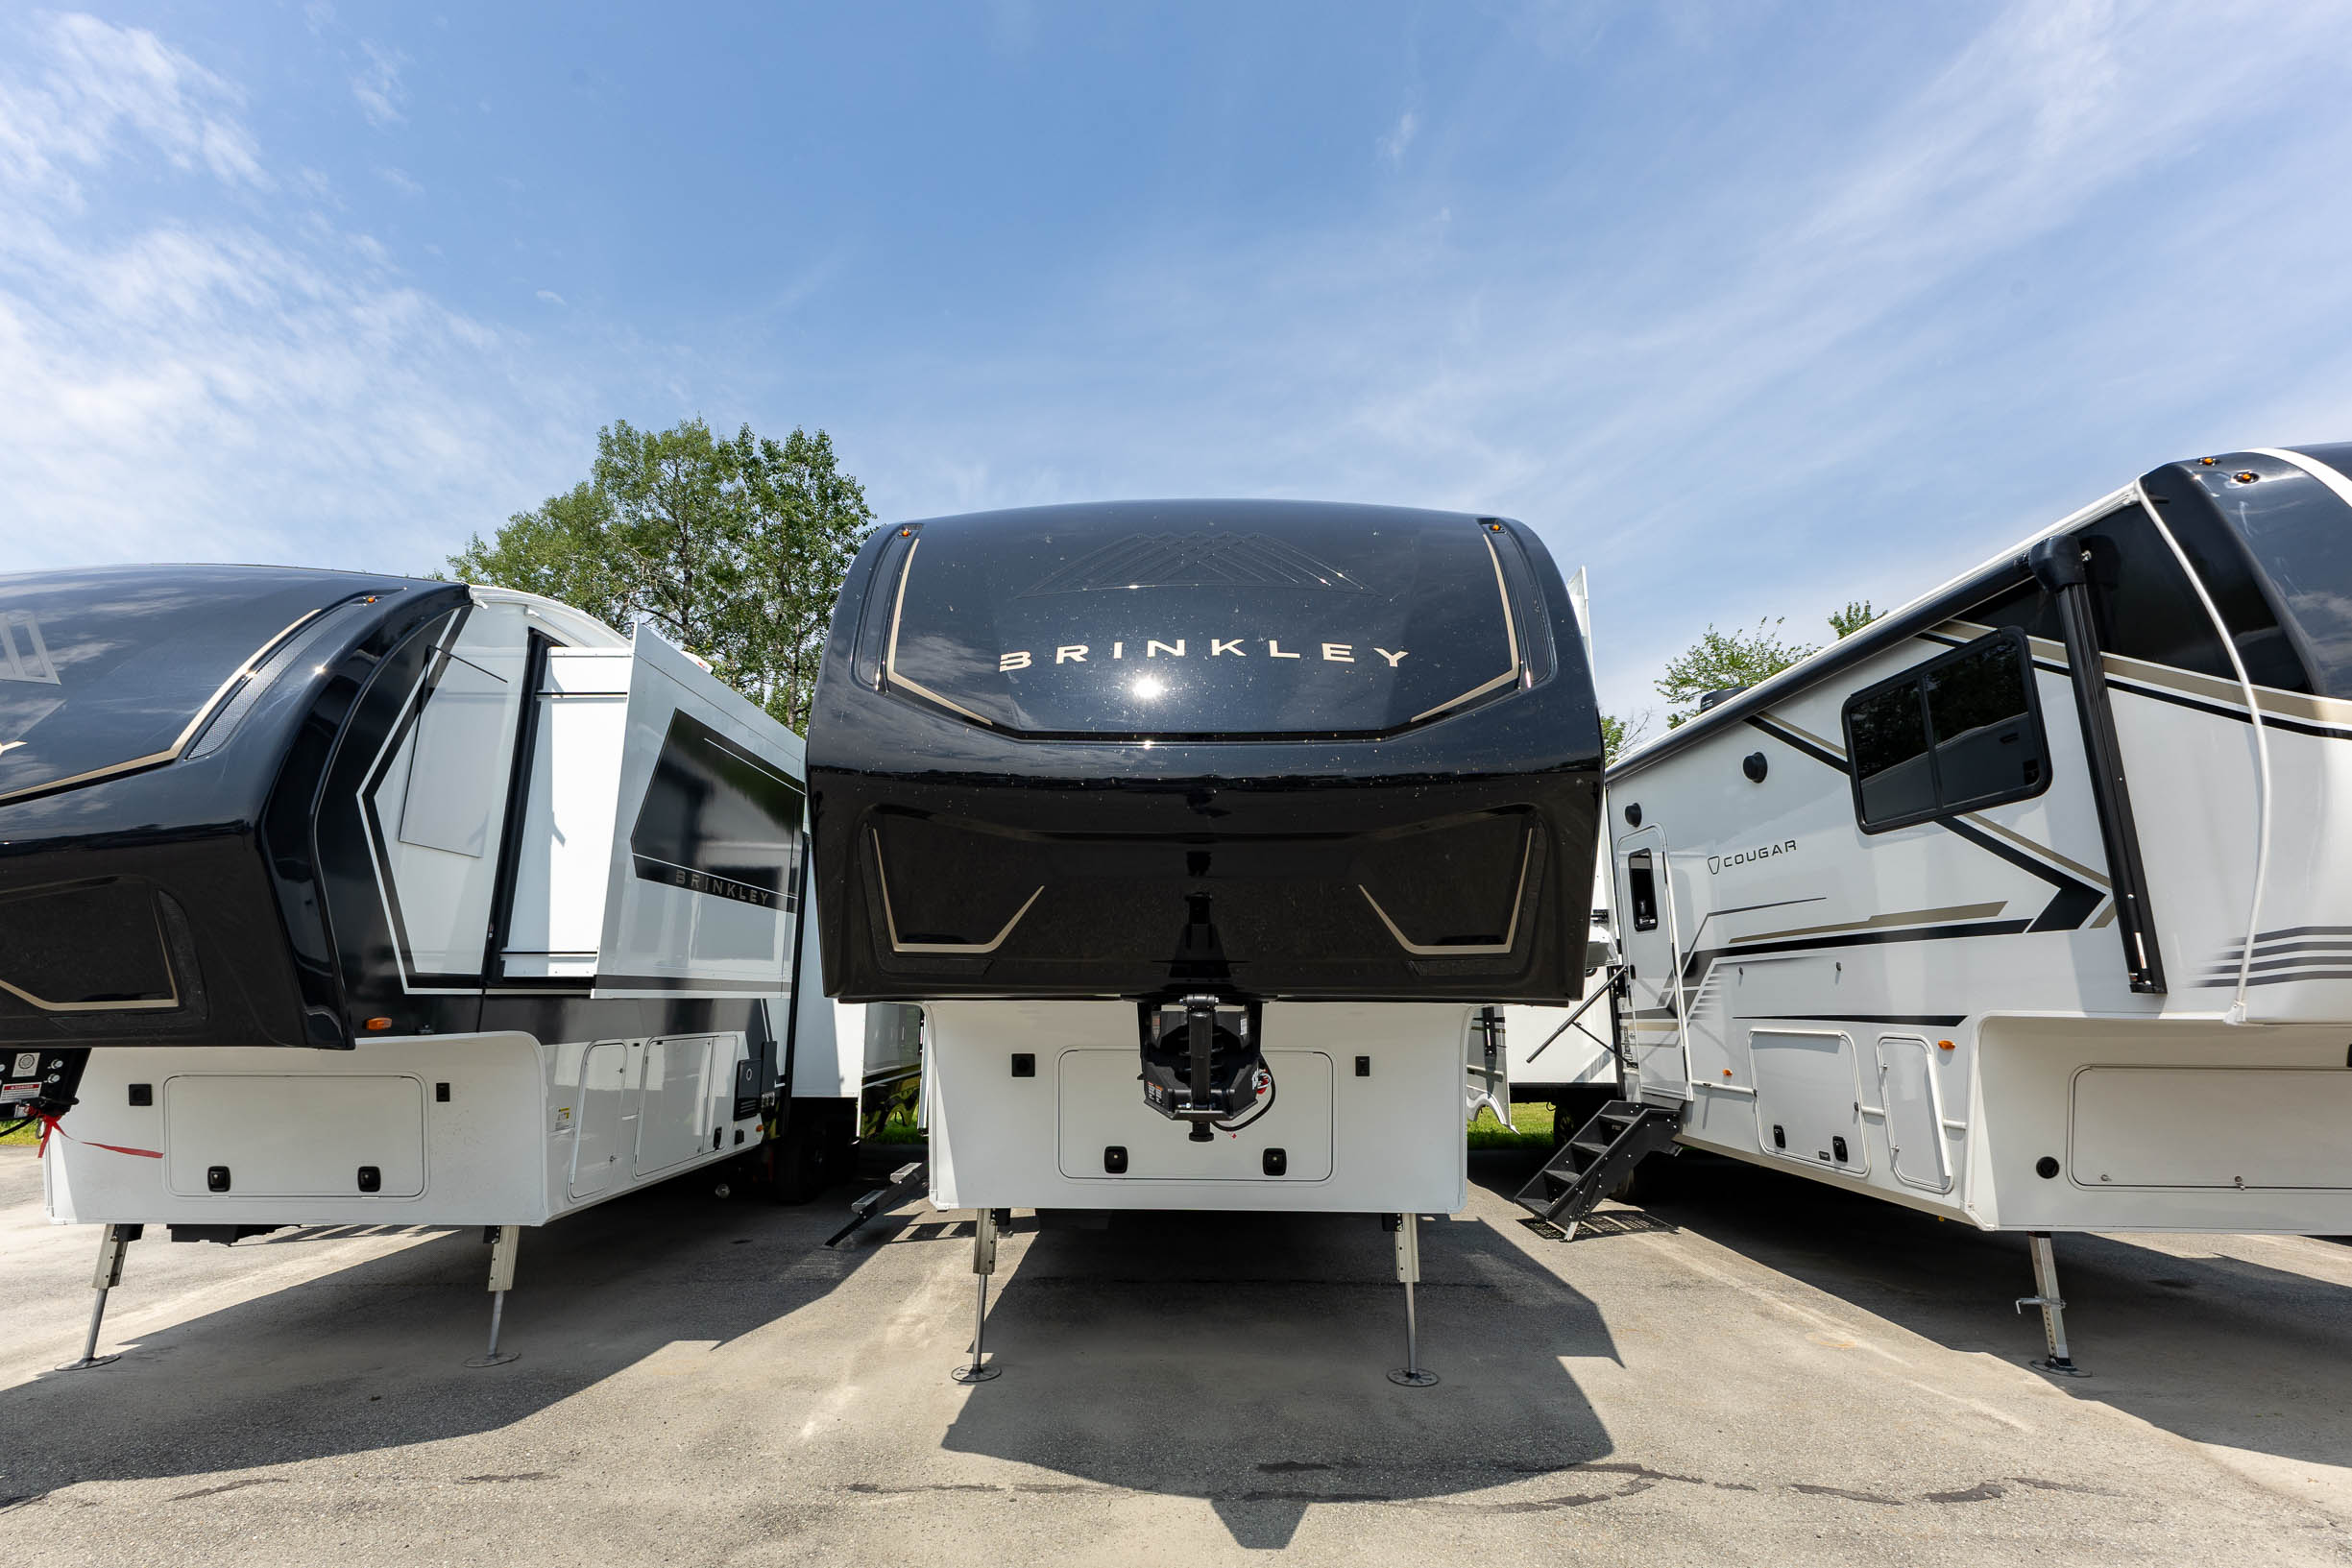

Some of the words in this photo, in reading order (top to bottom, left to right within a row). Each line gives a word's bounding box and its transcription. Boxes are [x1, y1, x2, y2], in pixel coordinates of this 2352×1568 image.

[1000, 639, 1409, 672] BRINKLEY
[1724, 839, 1797, 868] COUGAR
[675, 869, 769, 905] BRINKLEY
